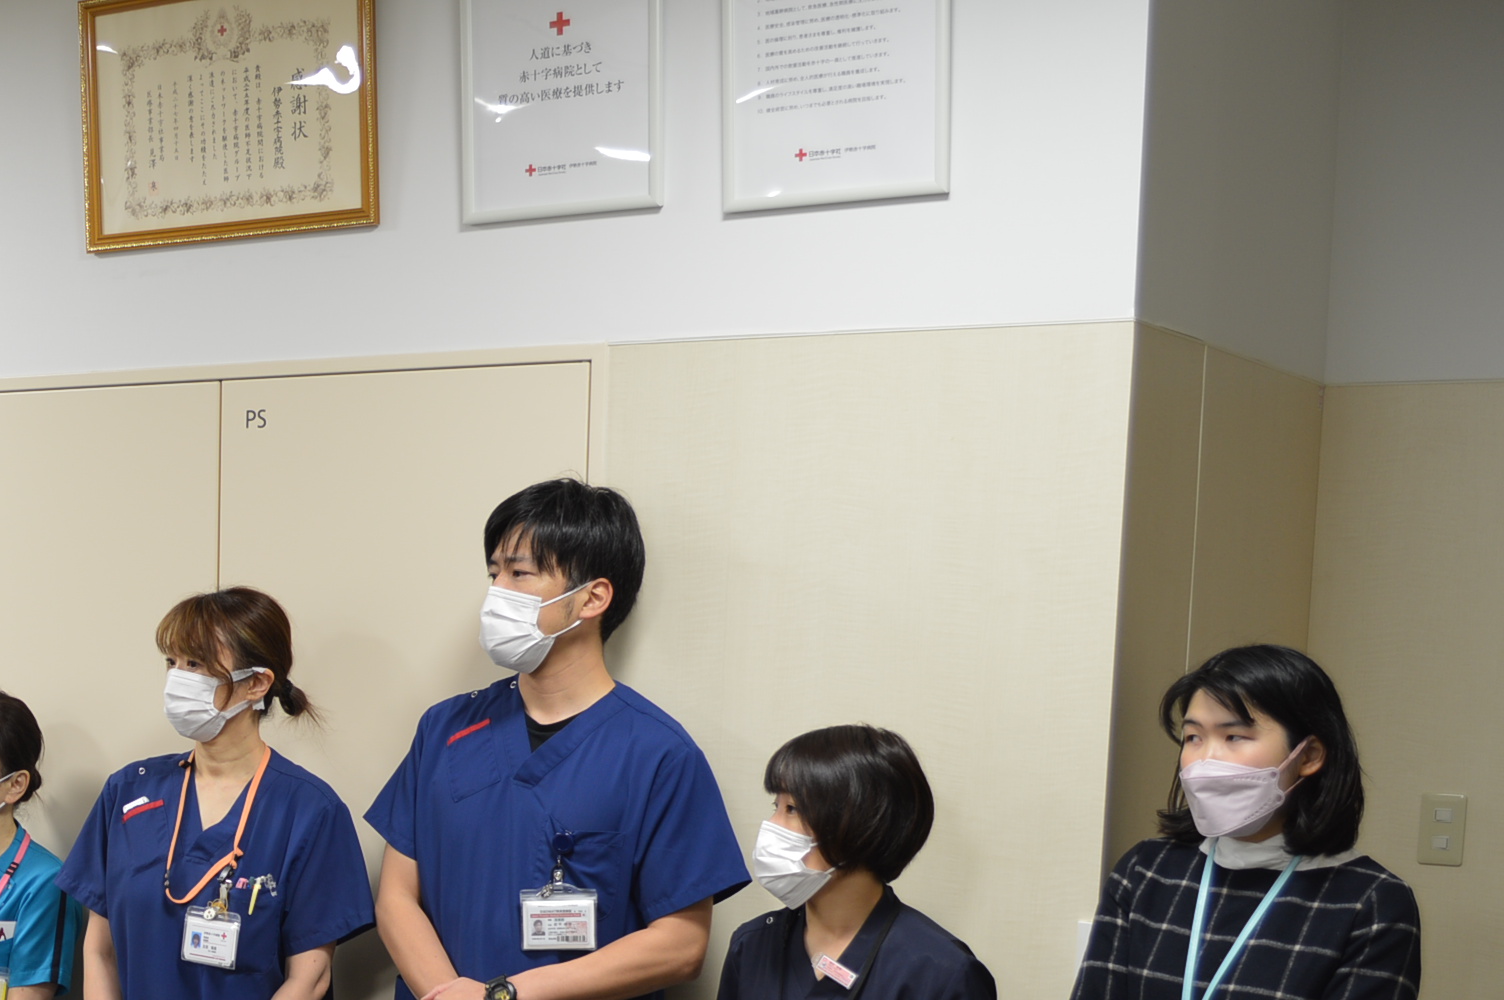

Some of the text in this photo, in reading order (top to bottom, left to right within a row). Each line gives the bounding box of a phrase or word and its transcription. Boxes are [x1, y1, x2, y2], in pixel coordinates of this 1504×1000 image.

[529, 41, 592, 61] 人道に基づき
[519, 61, 602, 83] 赤十字病院として
[290, 67, 309, 141] 感謝状
[498, 80, 625, 105] 質の高い医療を提供します
[271, 86, 286, 170] 伊勢赤十字病院殿
[246, 409, 266, 428] PS
